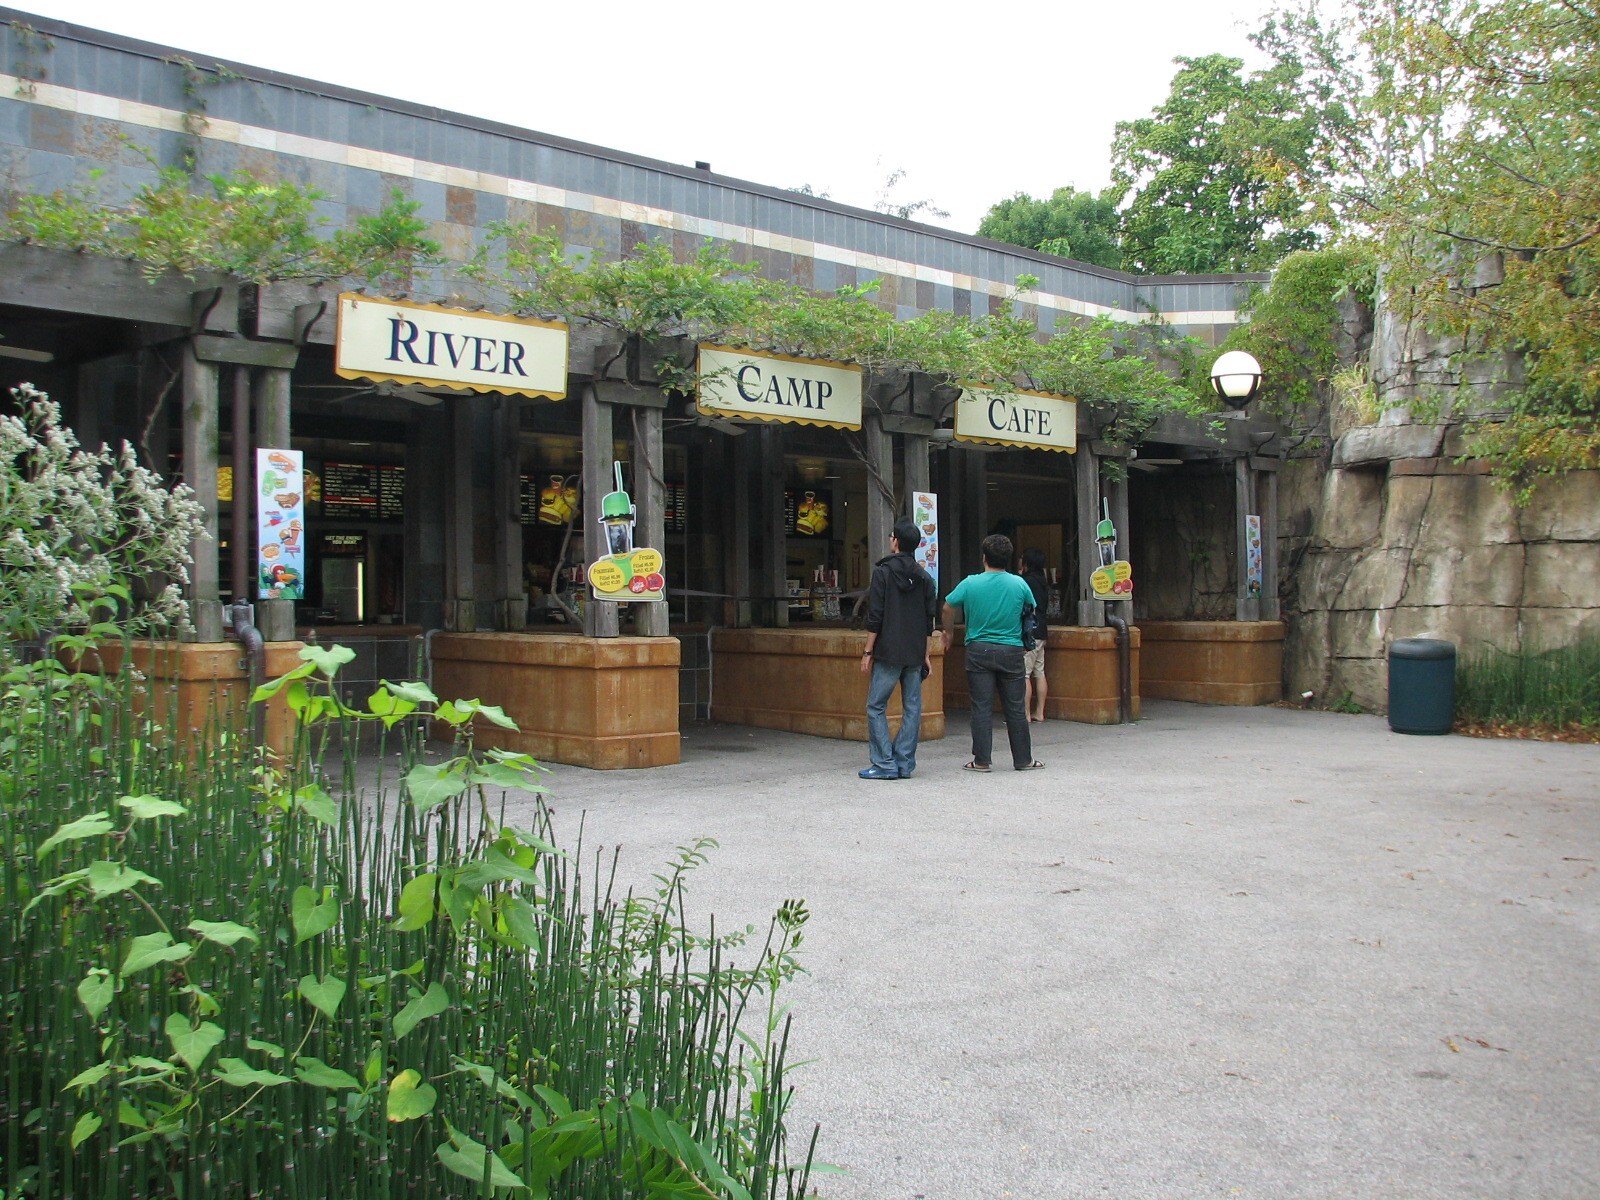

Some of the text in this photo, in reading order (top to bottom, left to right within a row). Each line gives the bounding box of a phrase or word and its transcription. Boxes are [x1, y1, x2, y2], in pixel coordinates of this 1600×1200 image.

[384, 317, 529, 377] RIVER
[737, 365, 833, 410] CAMP
[988, 398, 1053, 436] CAFE
